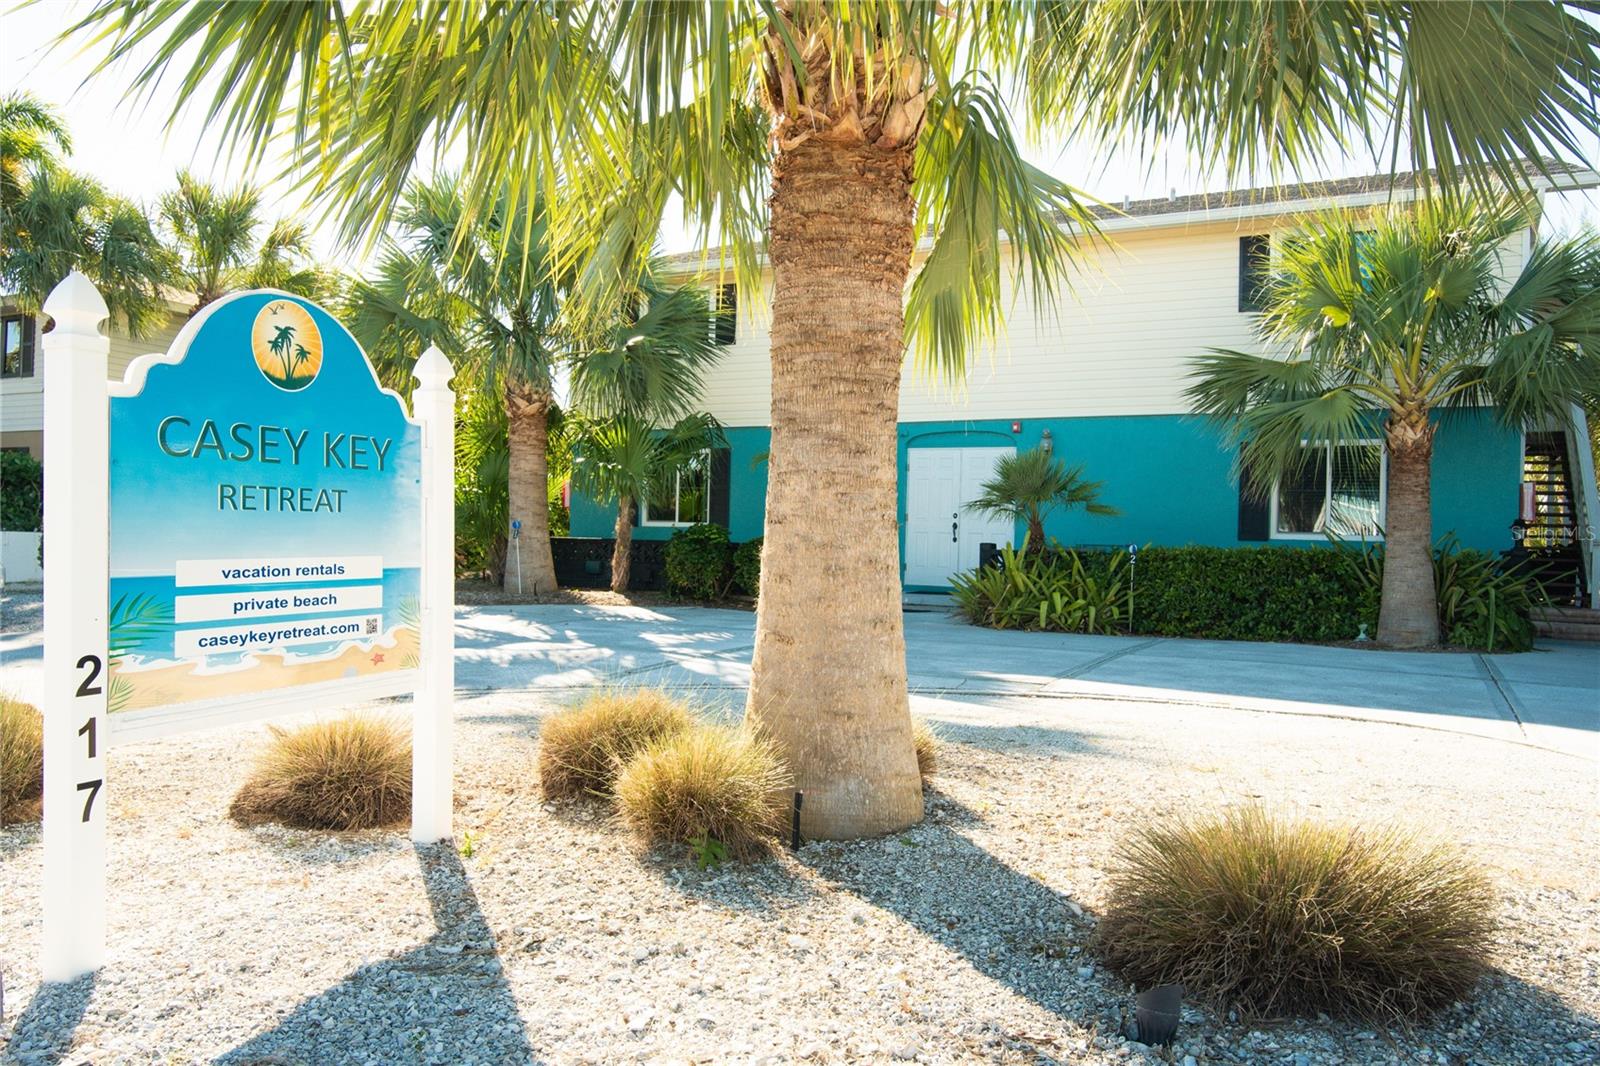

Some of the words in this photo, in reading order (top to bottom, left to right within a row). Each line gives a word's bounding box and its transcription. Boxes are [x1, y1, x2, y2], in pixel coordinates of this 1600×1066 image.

[157, 416, 308, 465] CASEY
[323, 432, 392, 471] KEY
[217, 483, 348, 513] RETREAT
[221, 564, 291, 579] vacation
[295, 563, 345, 577] rentals
[233, 597, 289, 614] private
[293, 593, 338, 608] beach
[198, 621, 360, 648] caseykeyretreat.com
